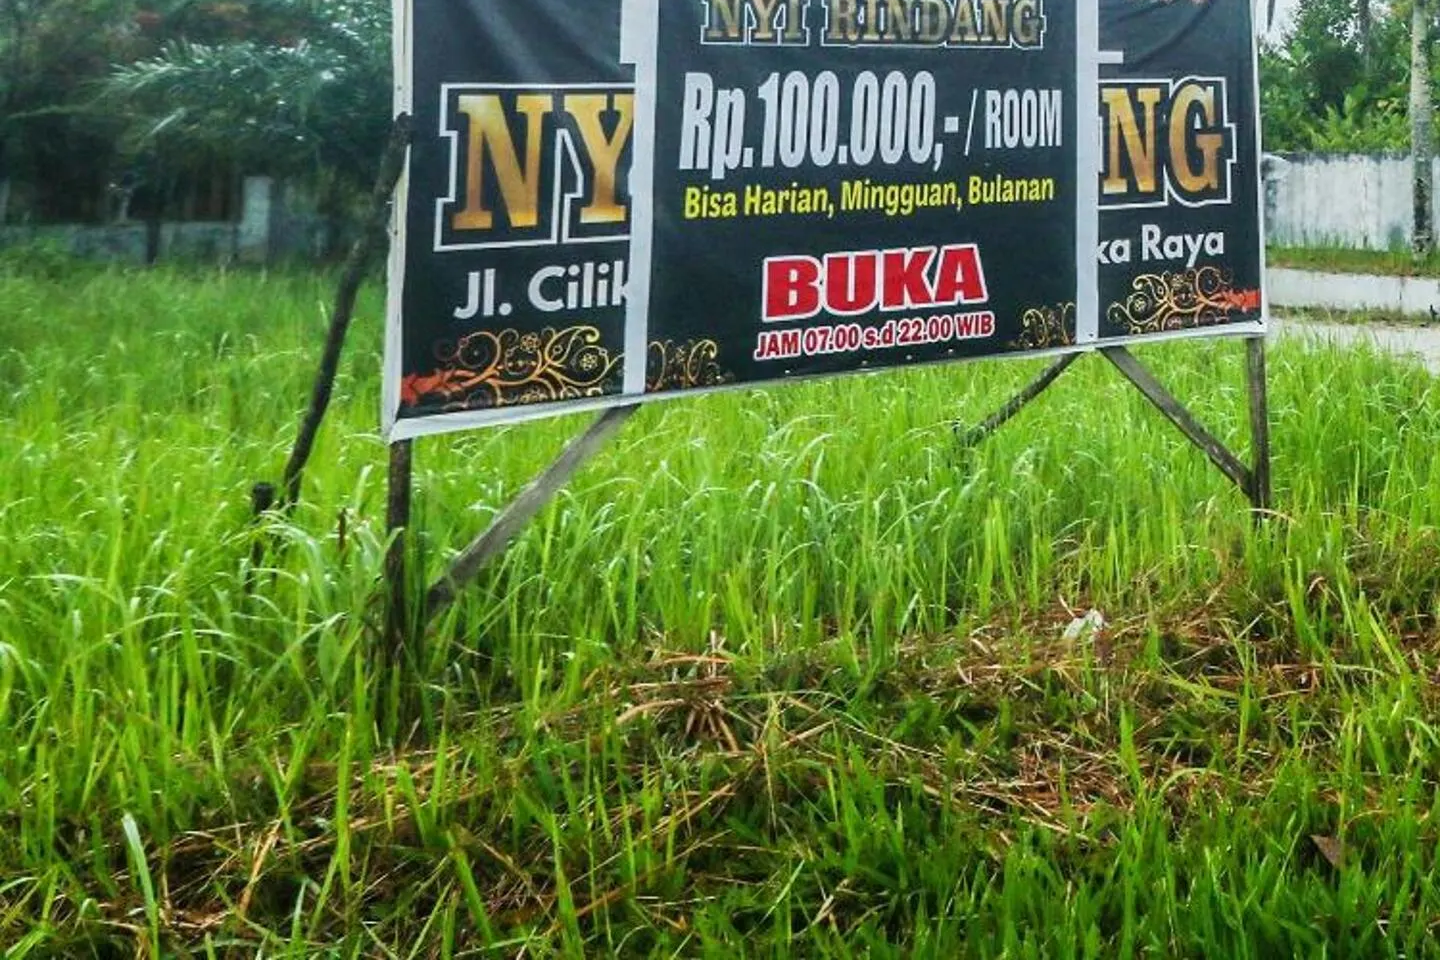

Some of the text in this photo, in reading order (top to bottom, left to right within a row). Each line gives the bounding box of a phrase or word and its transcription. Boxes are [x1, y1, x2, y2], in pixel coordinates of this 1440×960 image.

[684, 174, 1054, 220] Bisa Harian, Mingguan, Bulanan
[1141, 224, 1225, 269] Raya
[453, 268, 513, 320] Jl.
[763, 245, 987, 321] BUKA
[755, 311, 995, 360] JAM 07.00 s.d 22.00 WIB
